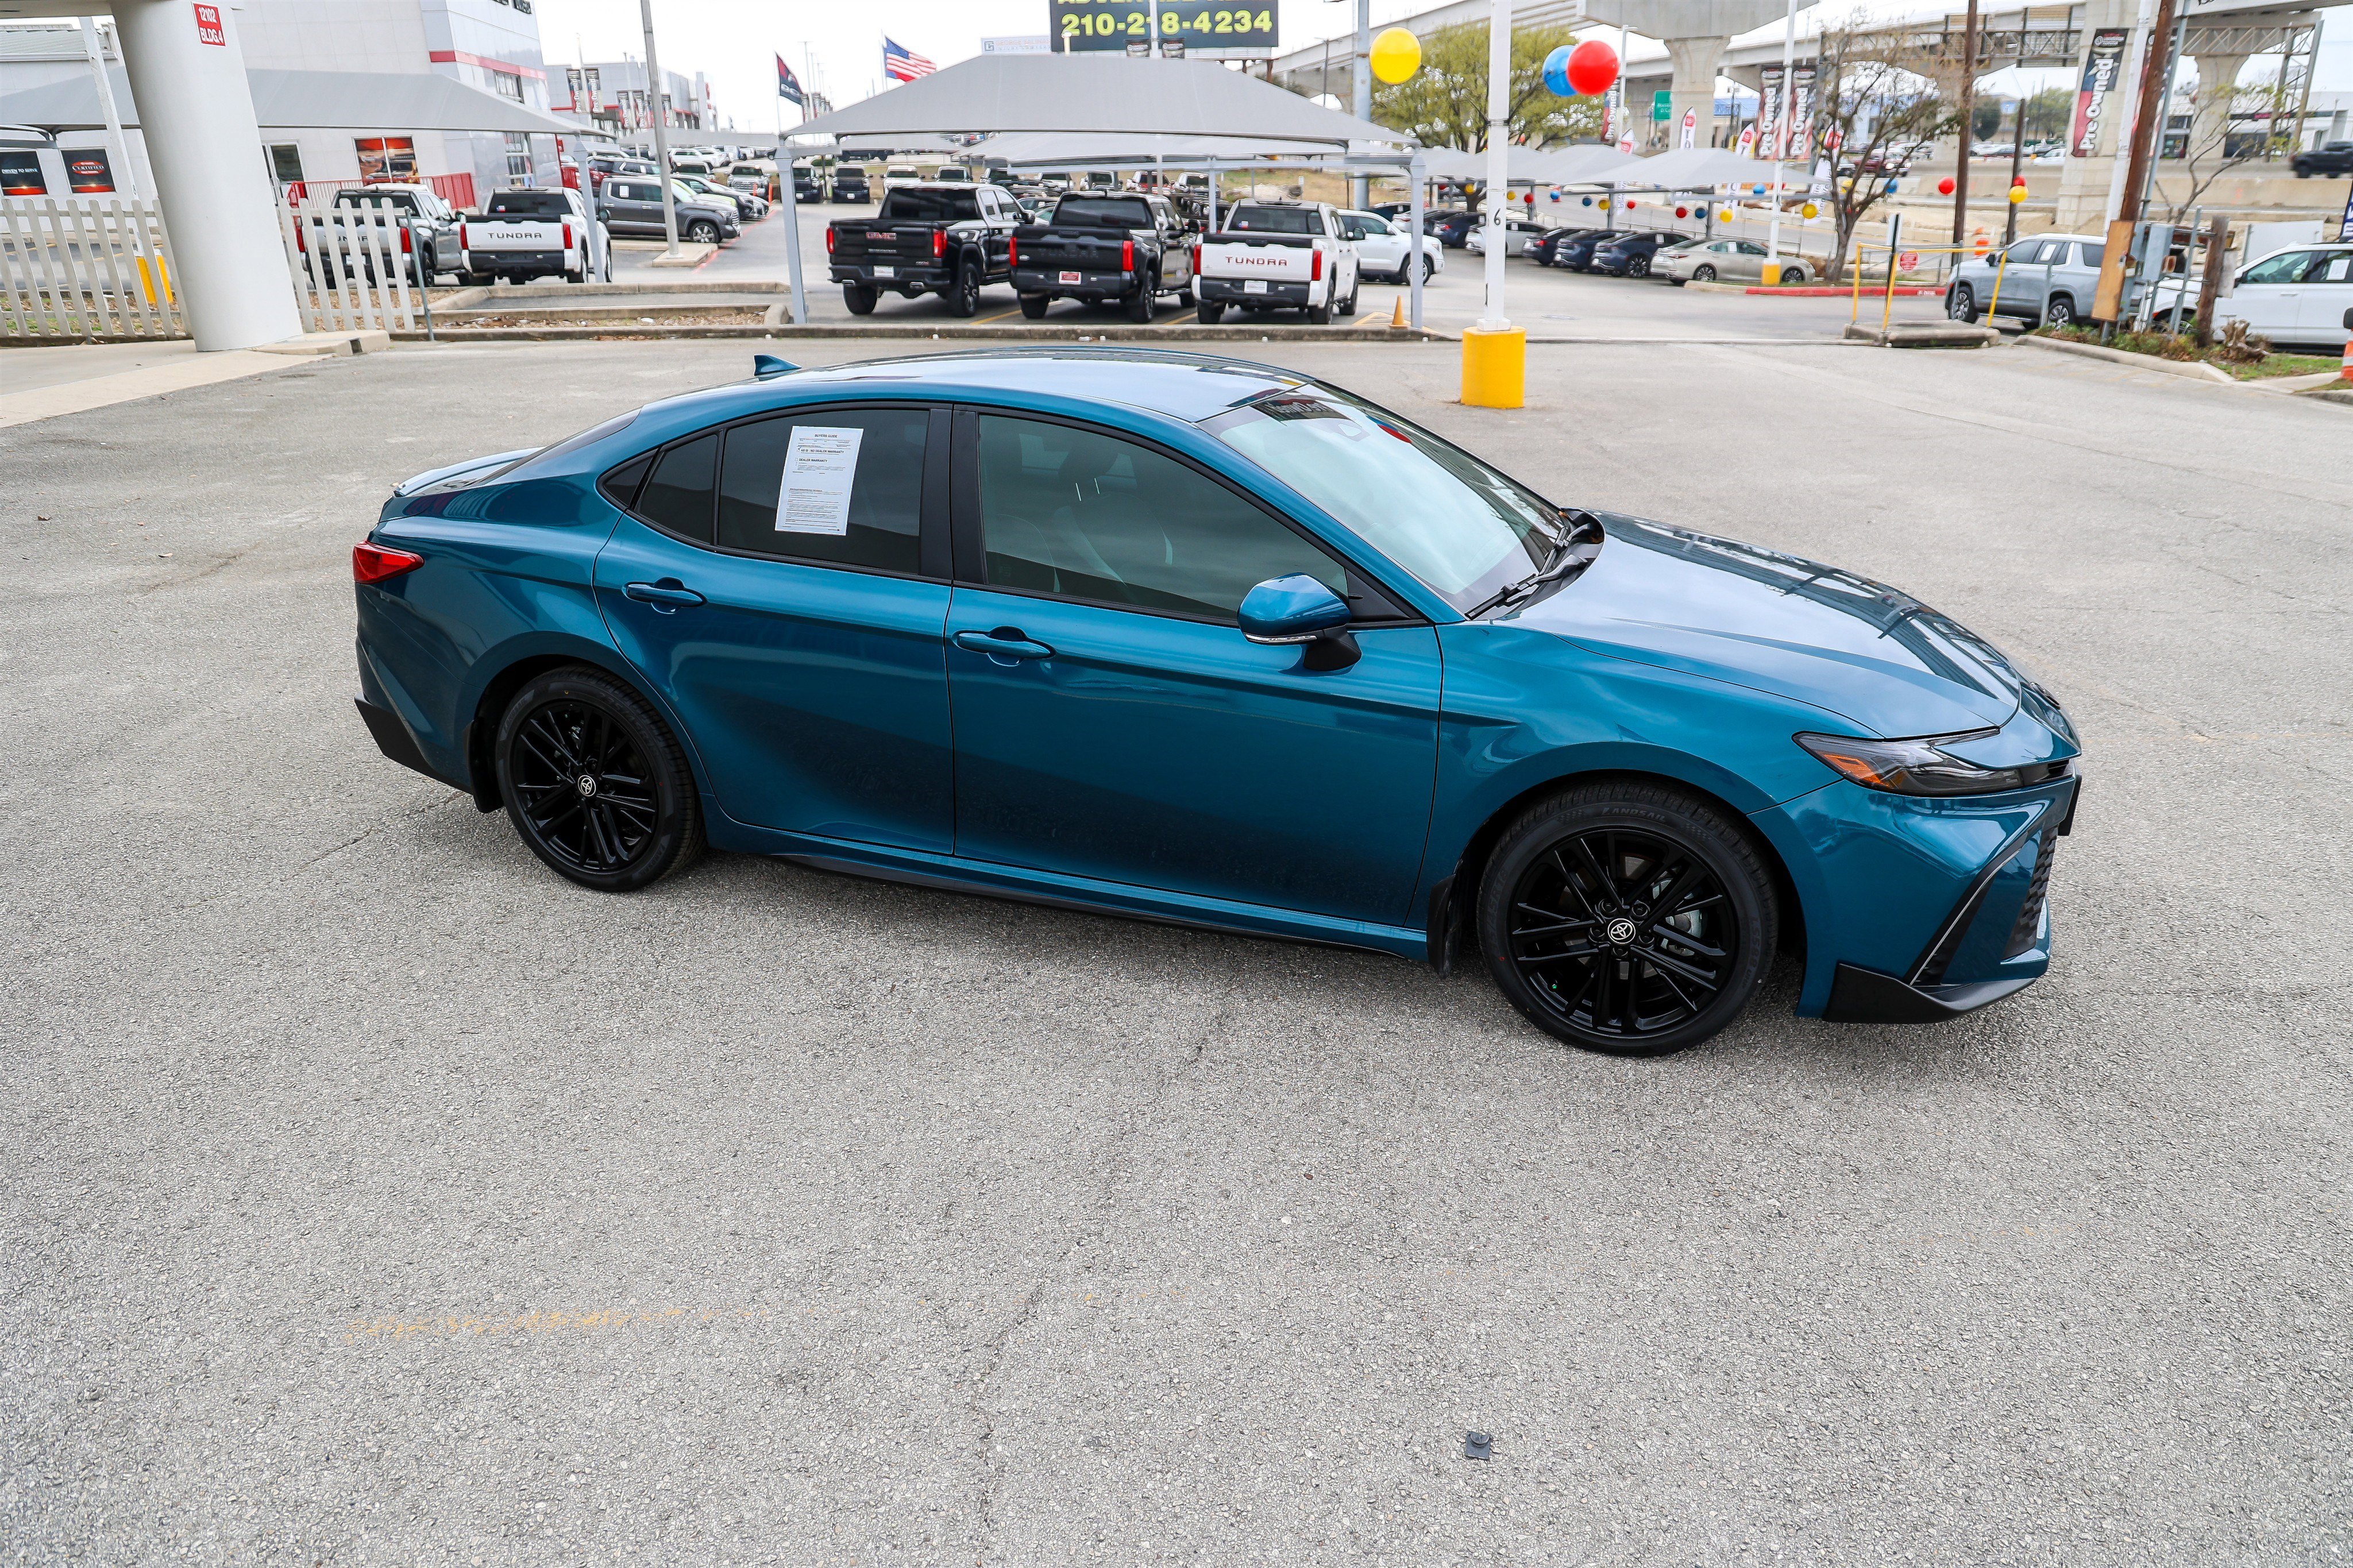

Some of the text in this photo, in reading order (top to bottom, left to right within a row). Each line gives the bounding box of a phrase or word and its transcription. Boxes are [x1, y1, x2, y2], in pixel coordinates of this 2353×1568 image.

[198, 6, 217, 23] 12102
[1061, 10, 1273, 36] 210-28-4234
[2085, 59, 2114, 118] Owned
[1762, 87, 1777, 133] Owned
[1793, 87, 1808, 133] Owned
[1604, 123, 1615, 140] Pre
[2078, 121, 2099, 150] Pre
[1759, 133, 1773, 157] Pre
[1790, 133, 1804, 157] Pre
[1494, 207, 1501, 225] 6
[866, 232, 897, 240] GMC
[1225, 256, 1287, 266] TUNDRA
[1601, 807, 1666, 822] LANDSAIL
